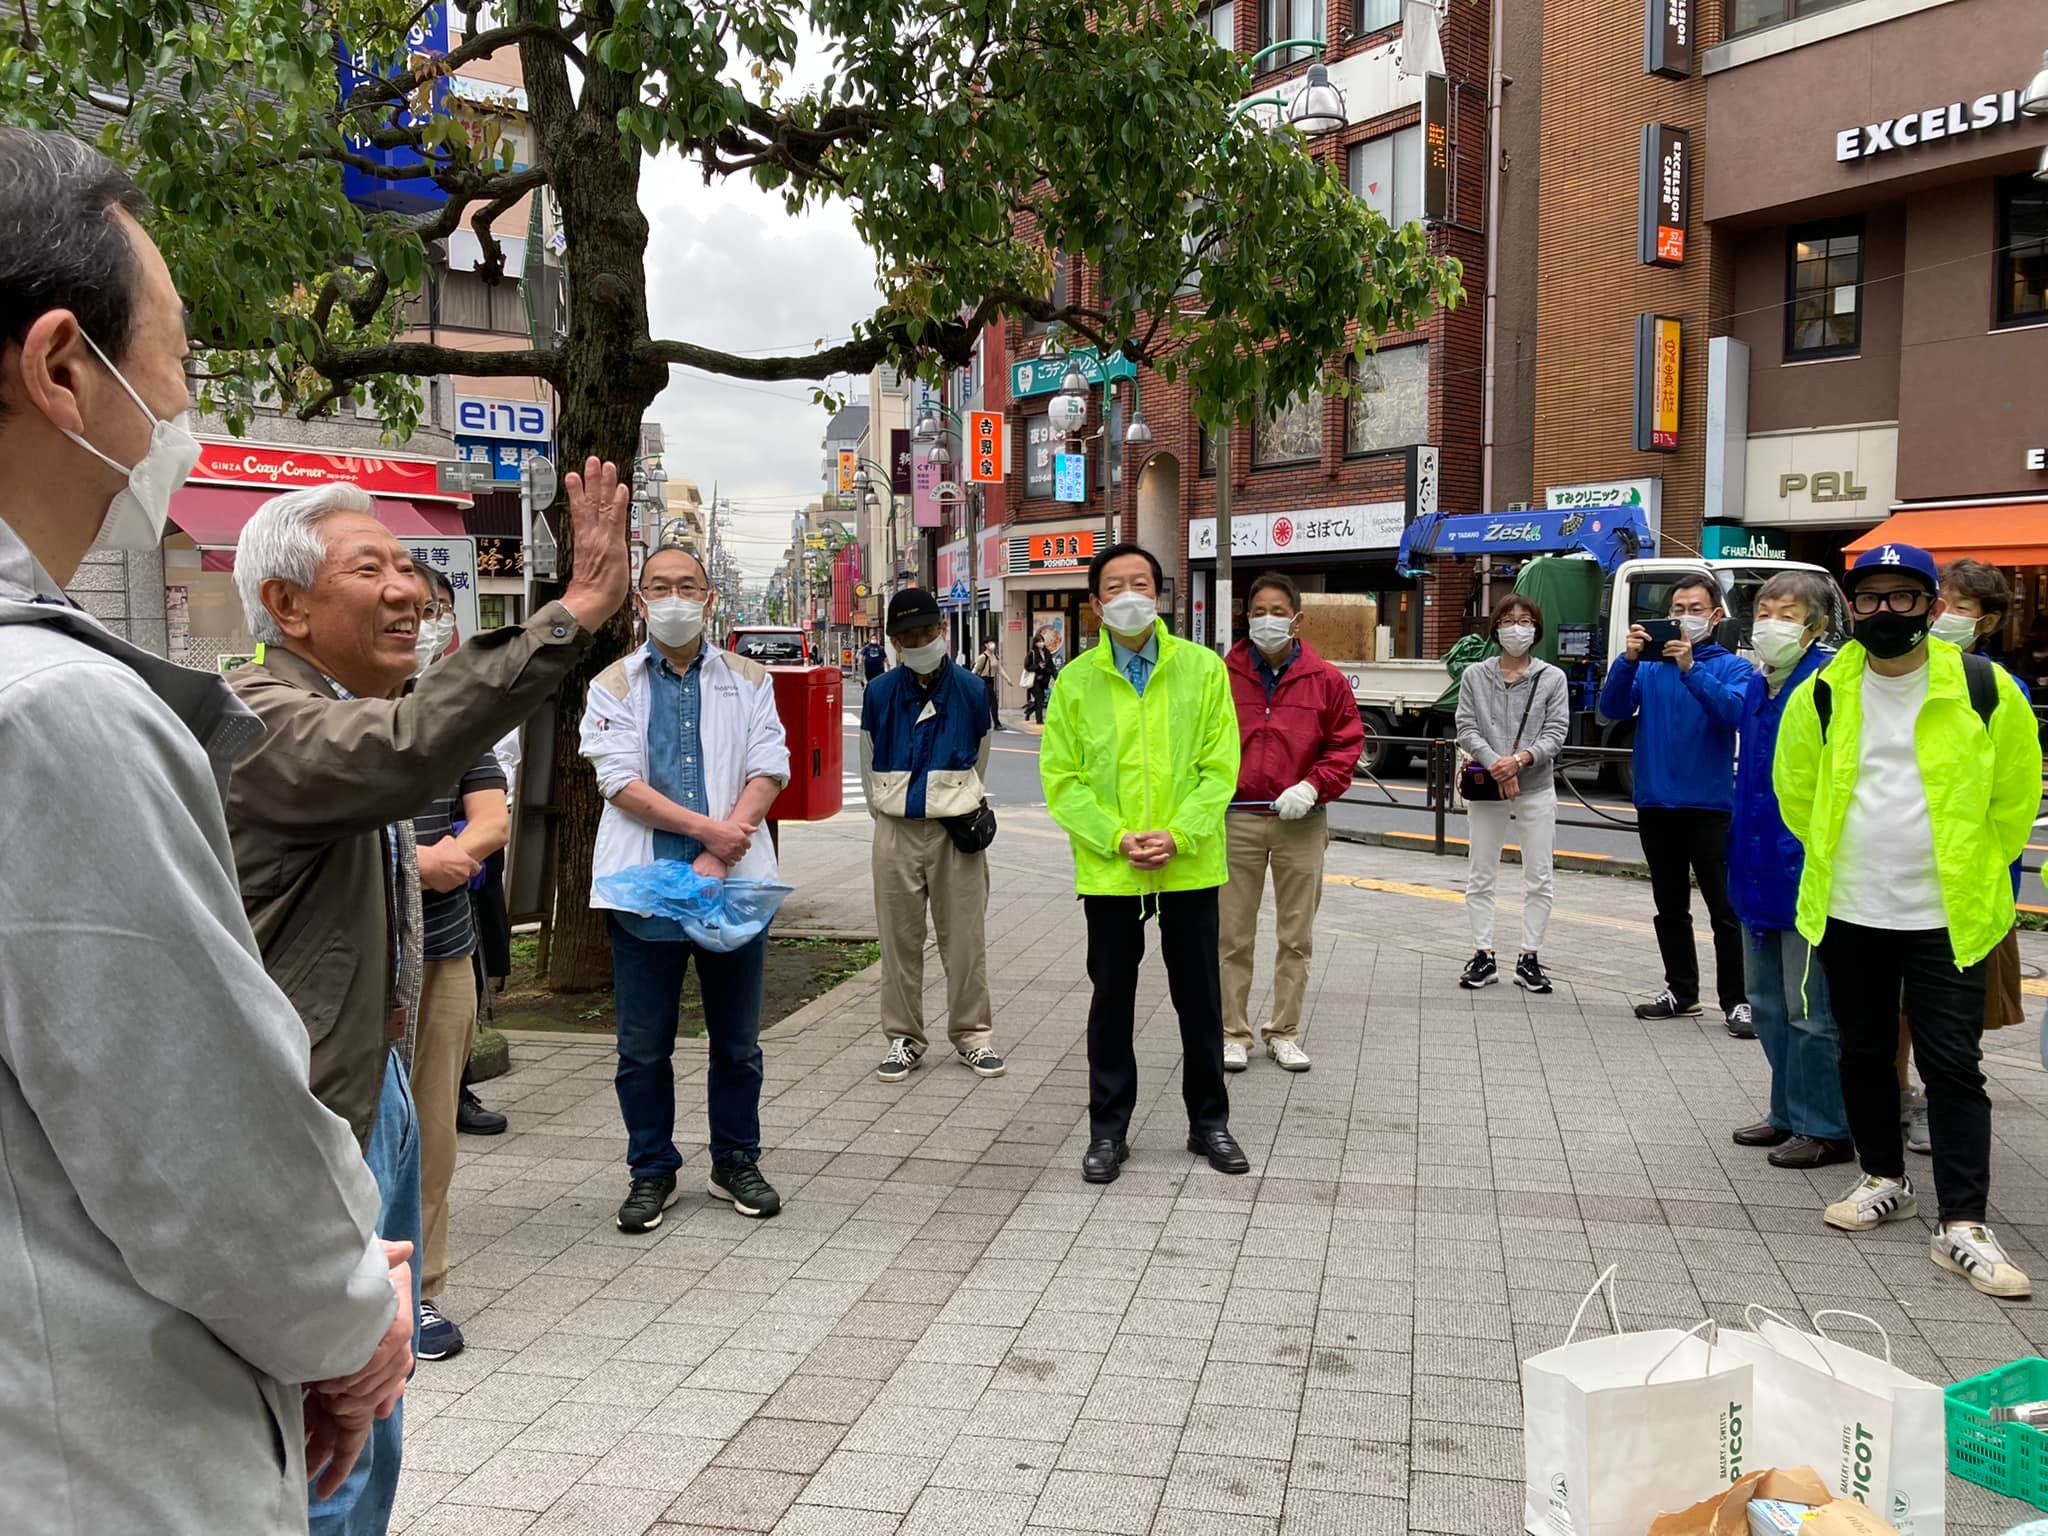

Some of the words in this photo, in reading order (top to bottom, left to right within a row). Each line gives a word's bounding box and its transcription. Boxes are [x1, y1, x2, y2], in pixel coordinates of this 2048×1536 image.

[1677, 0, 1686, 45] LSIOR
[1671, 141, 1682, 222] EXCELSIOR
[460, 401, 544, 434] ena
[981, 418, 993, 476] 吉野家
[211, 461, 241, 472] GINZA
[243, 456, 282, 481] Cozy
[282, 461, 325, 478] Corner
[1555, 489, 1620, 505] すみクリニック
[1779, 471, 1868, 498] PAL
[1306, 519, 1354, 539] さぼてん
[1483, 521, 1533, 542] Zest
[1042, 536, 1079, 557] 吉野家
[1731, 547, 1748, 557] HAIR
[1748, 535, 1769, 559] Ash
[1880, 545, 1900, 565] LA
[1719, 1412, 1727, 1440] SWEETS
[1729, 1401, 1743, 1483] PICOT
[1842, 1425, 1853, 1455] SWEETS
[1719, 1452, 1728, 1479] BAKERY
[1840, 1463, 1849, 1494] BAKERY
